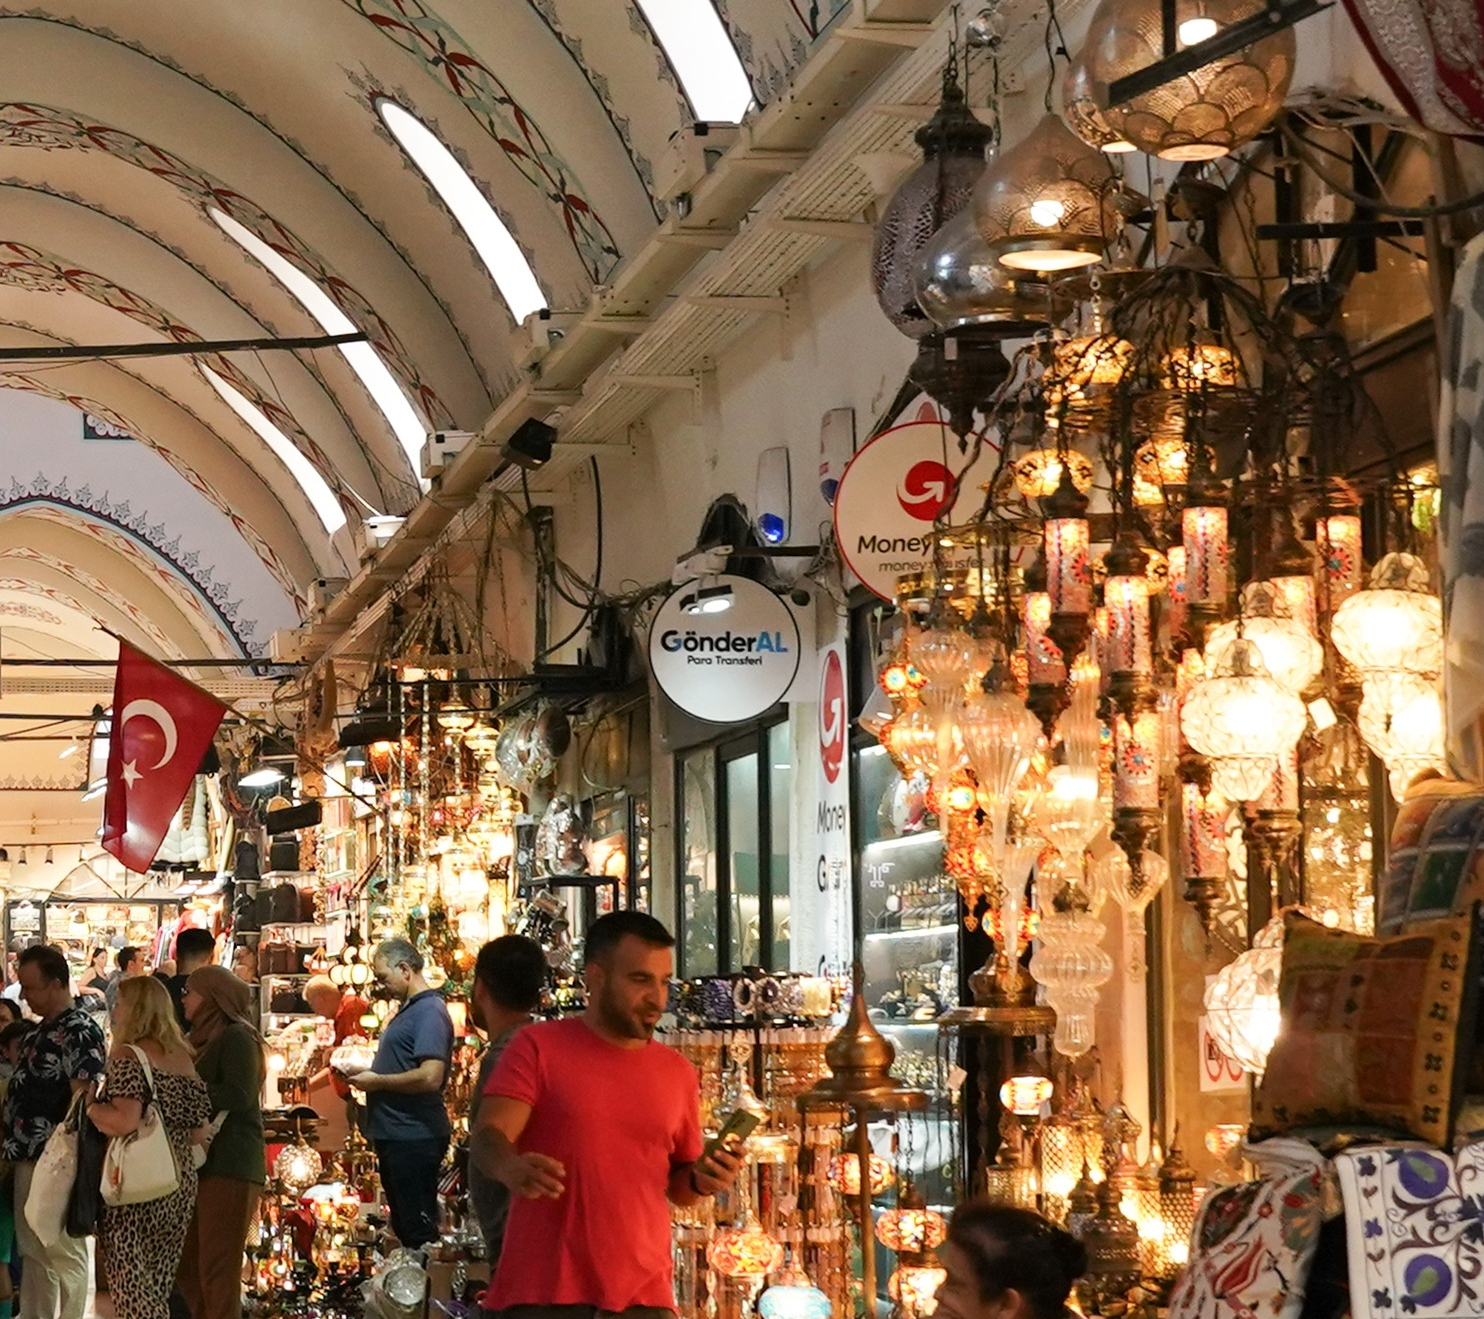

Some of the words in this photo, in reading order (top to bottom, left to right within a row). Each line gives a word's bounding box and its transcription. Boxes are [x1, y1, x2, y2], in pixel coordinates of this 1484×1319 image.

[660, 629, 788, 653] GönderAL
[687, 656, 712, 666] Para
[817, 801, 847, 835] Money
